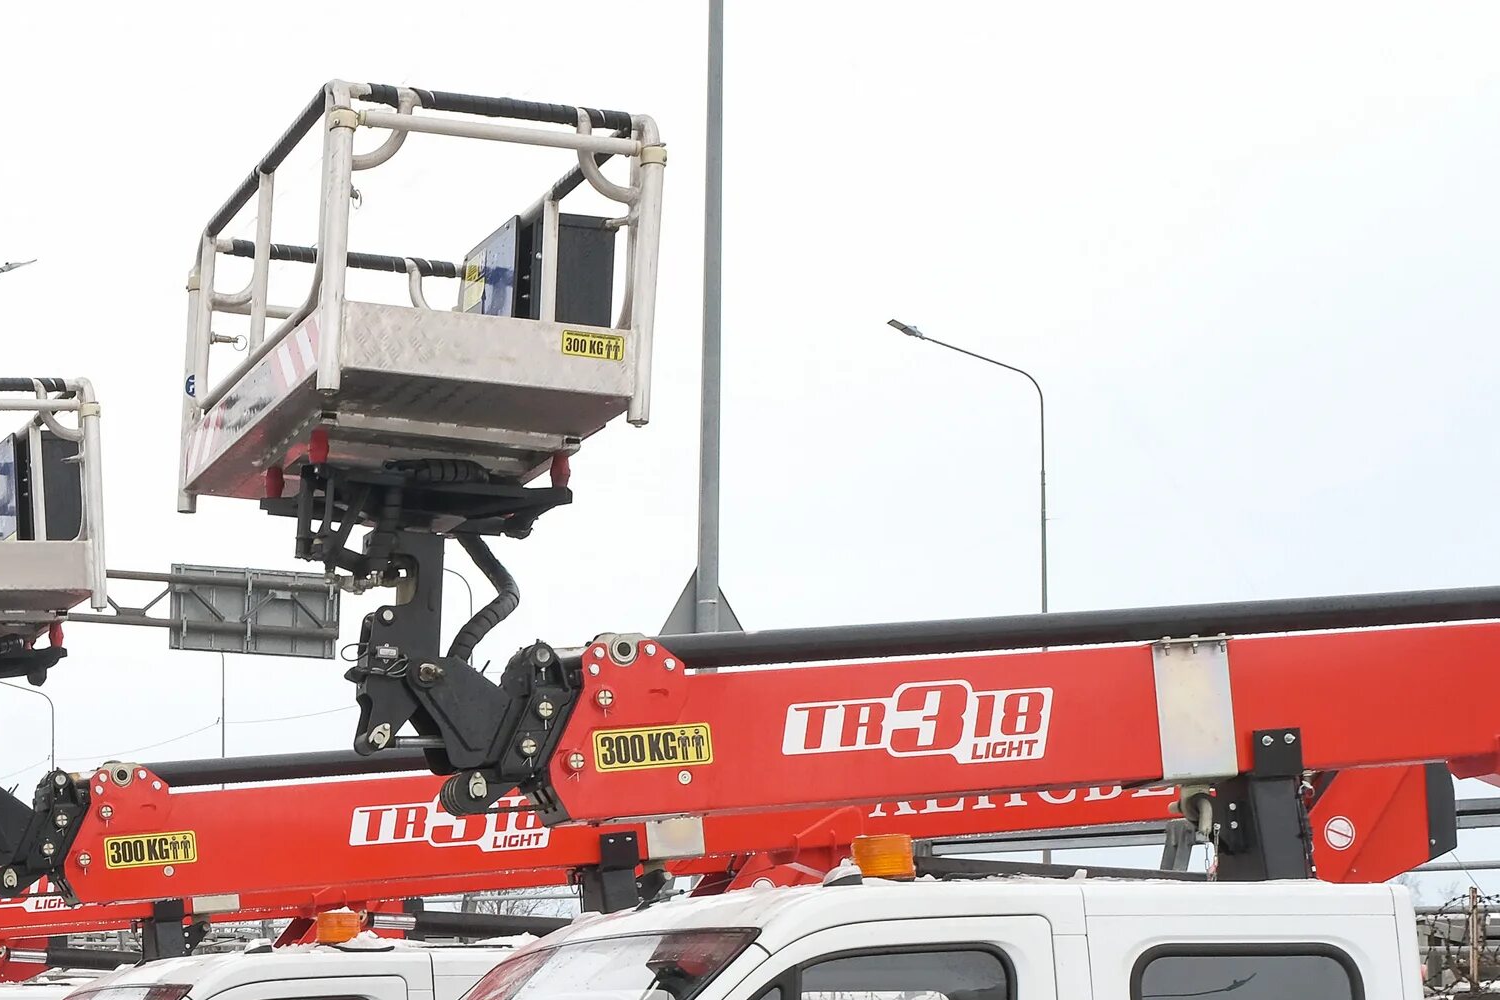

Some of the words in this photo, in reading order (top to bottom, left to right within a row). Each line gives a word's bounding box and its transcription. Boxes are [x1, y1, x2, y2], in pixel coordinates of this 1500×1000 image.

[565, 337, 587, 354] 300
[589, 339, 604, 355] KG
[600, 734, 646, 766] 300
[647, 731, 678, 762] KG
[971, 739, 1039, 760] LIGHT
[110, 839, 146, 864] 300
[146, 837, 171, 861] KG
[492, 833, 544, 849] LIGHT
[34, 897, 68, 910] LIGH
